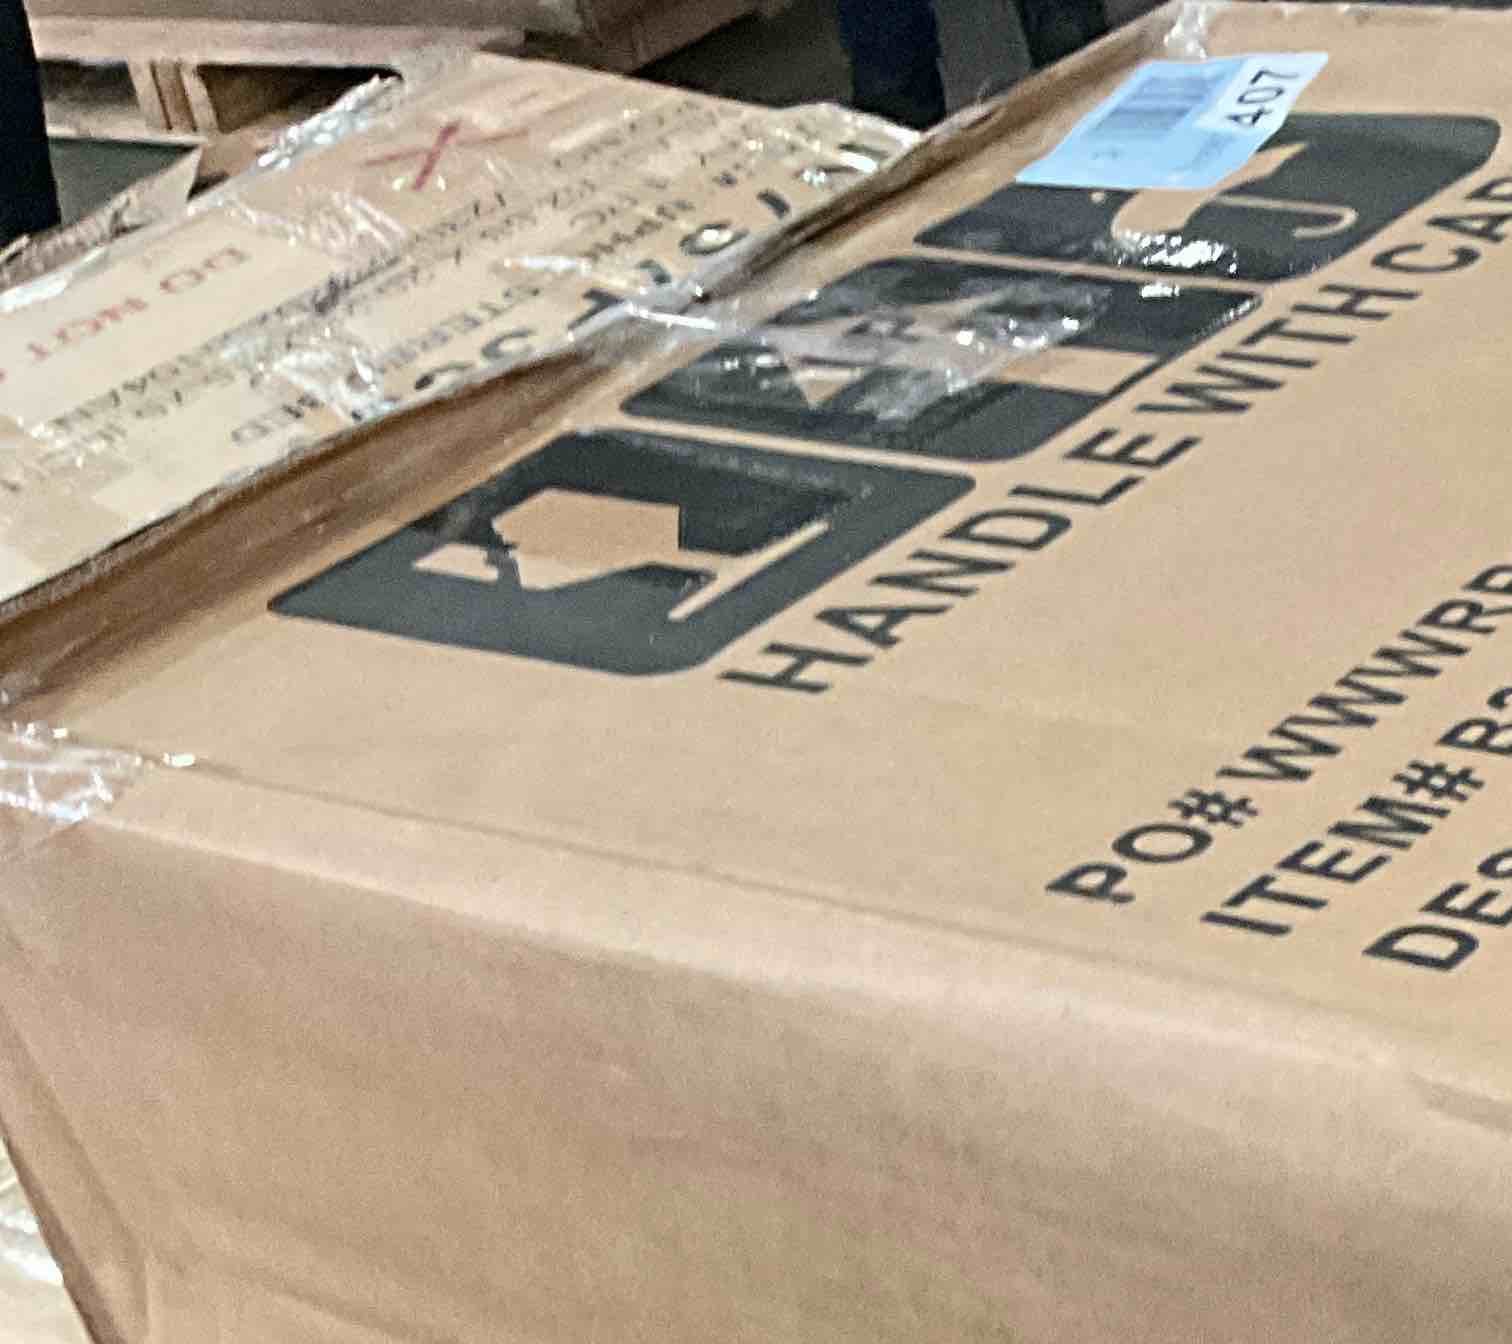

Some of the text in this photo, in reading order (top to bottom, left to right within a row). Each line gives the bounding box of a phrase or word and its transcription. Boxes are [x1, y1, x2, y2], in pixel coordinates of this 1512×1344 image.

[1227, 68, 1301, 128] 407
[717, 429, 1202, 693] HANDLE
[1135, 283, 1422, 415] WITH
[1045, 789, 1258, 904] PO#
[1200, 760, 1485, 936] ITEM#
